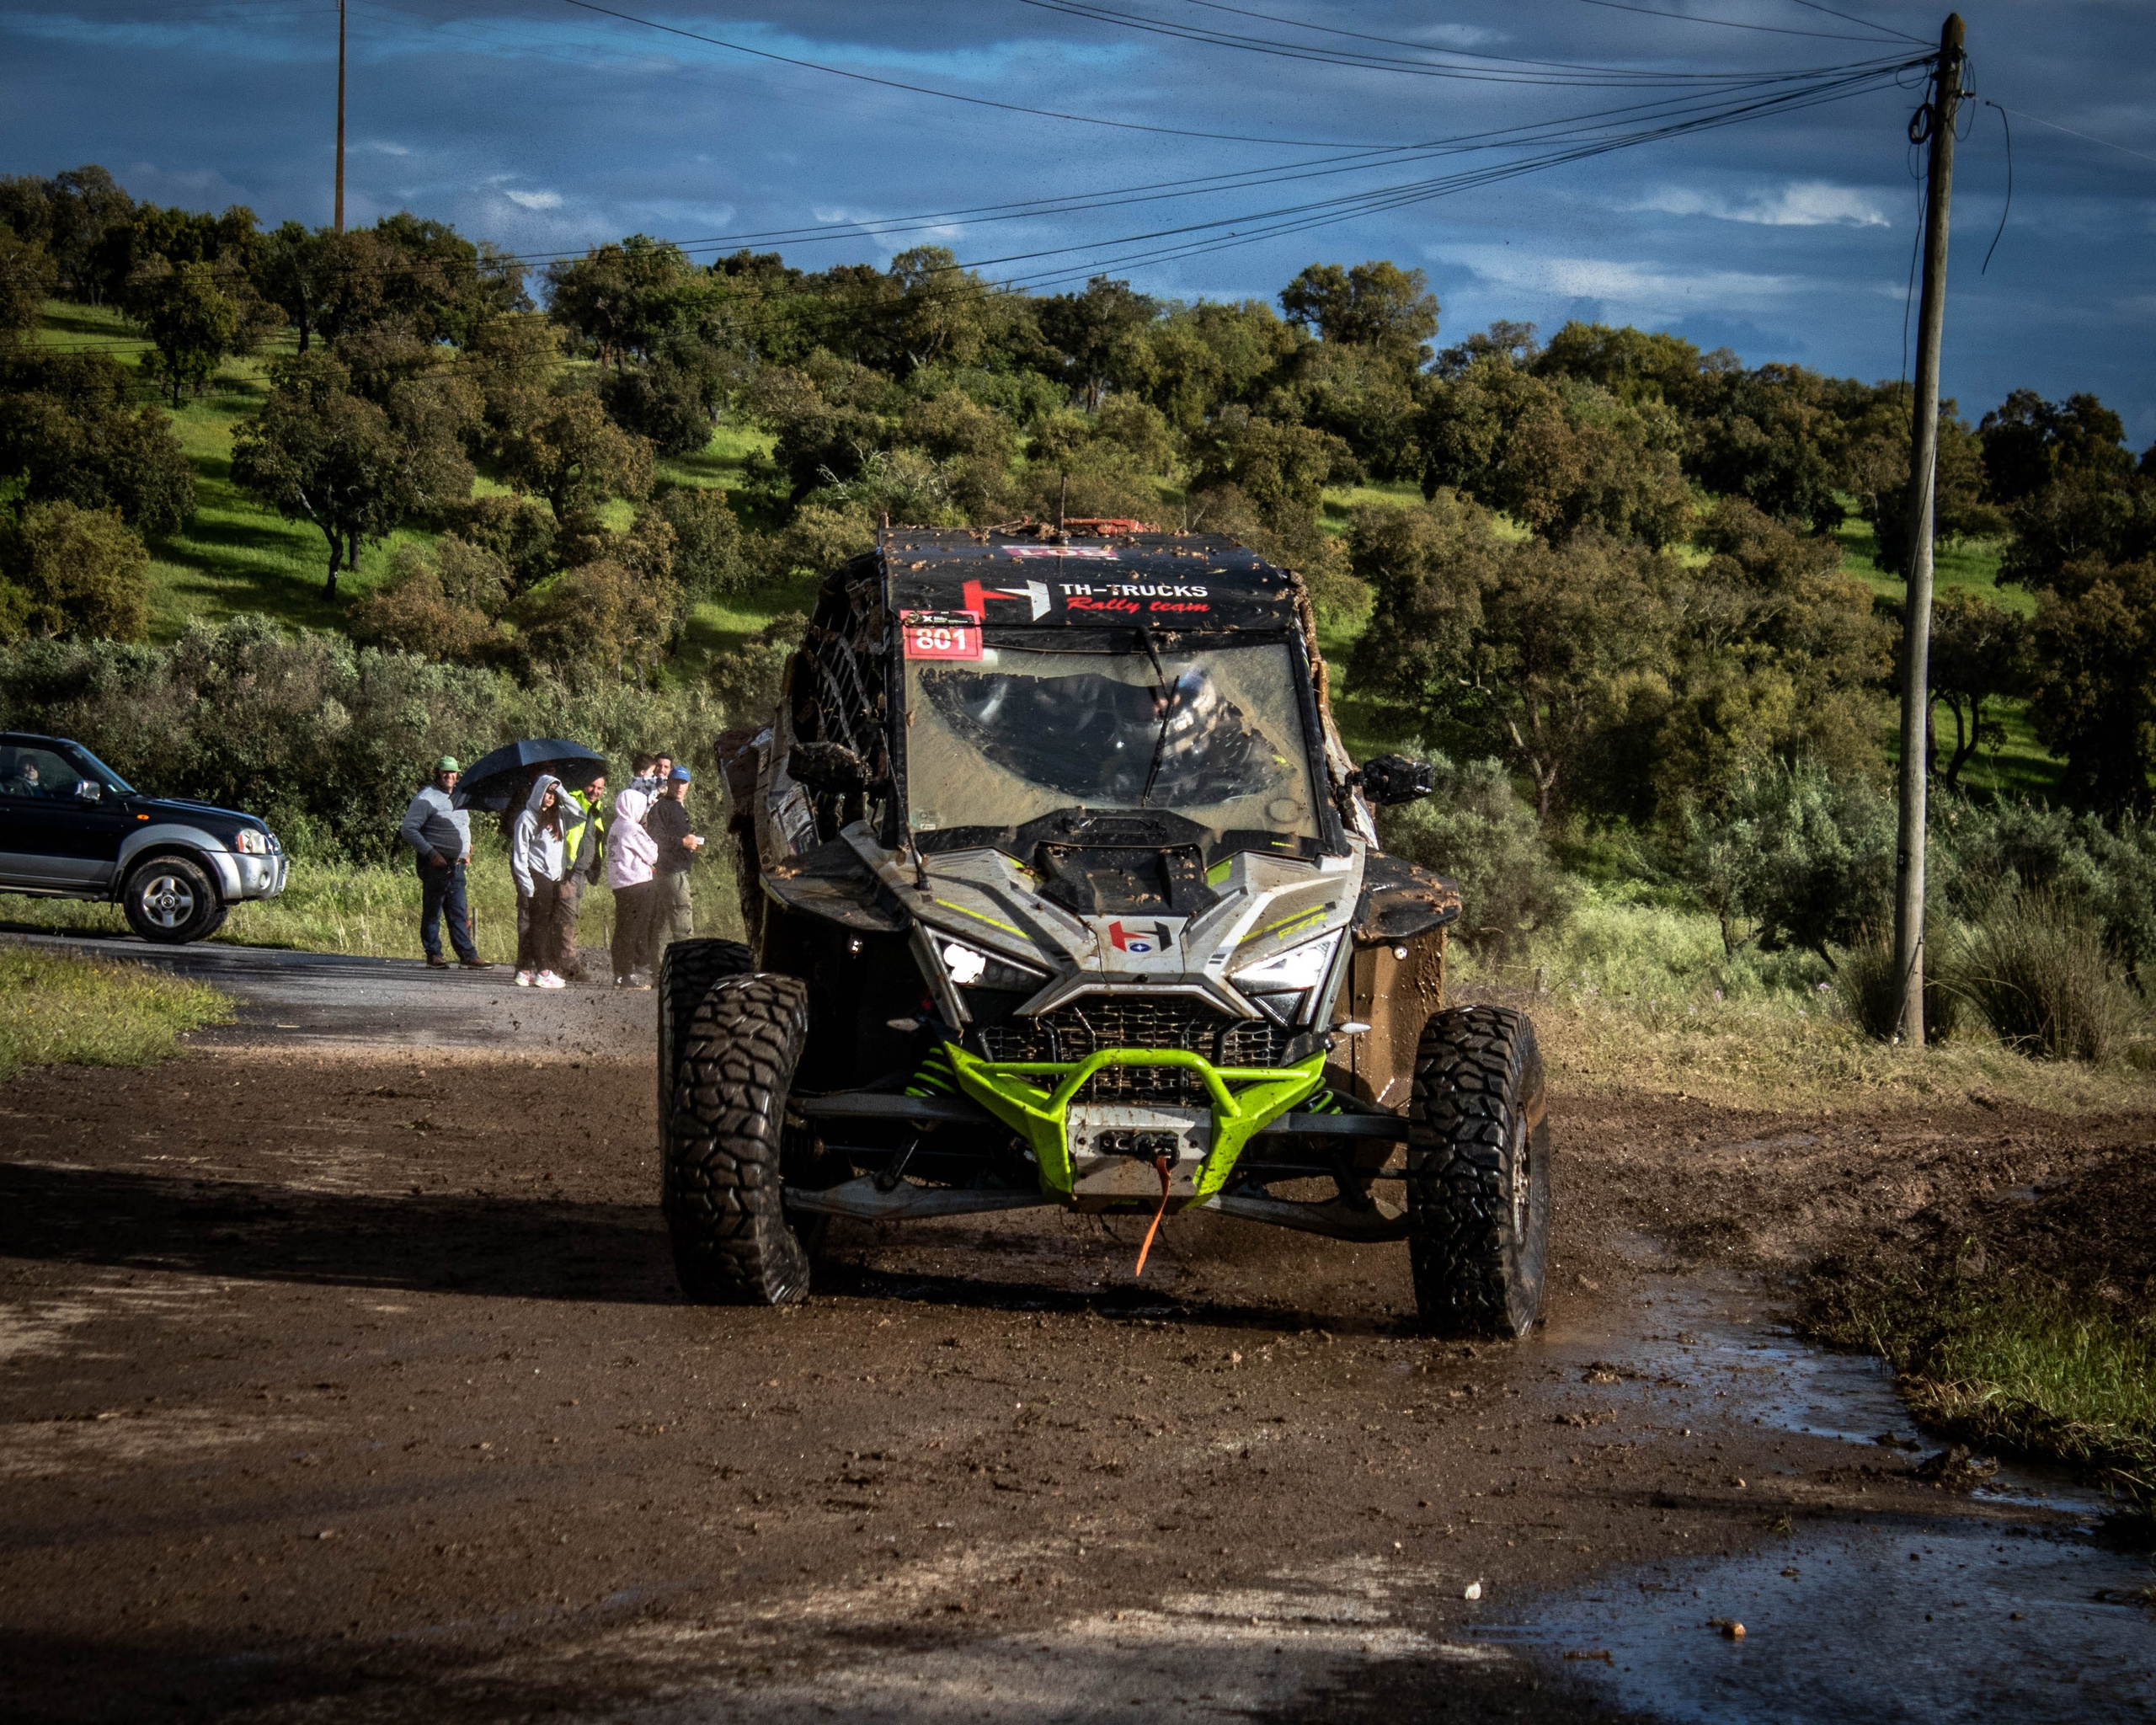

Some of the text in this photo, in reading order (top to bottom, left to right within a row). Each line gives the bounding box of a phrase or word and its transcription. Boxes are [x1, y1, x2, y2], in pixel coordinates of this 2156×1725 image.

[1018, 548, 1112, 557] 801
[1059, 584, 1209, 597] TH-TRUCKS
[1066, 596, 1211, 614] Rally team
[916, 628, 966, 650] 801
